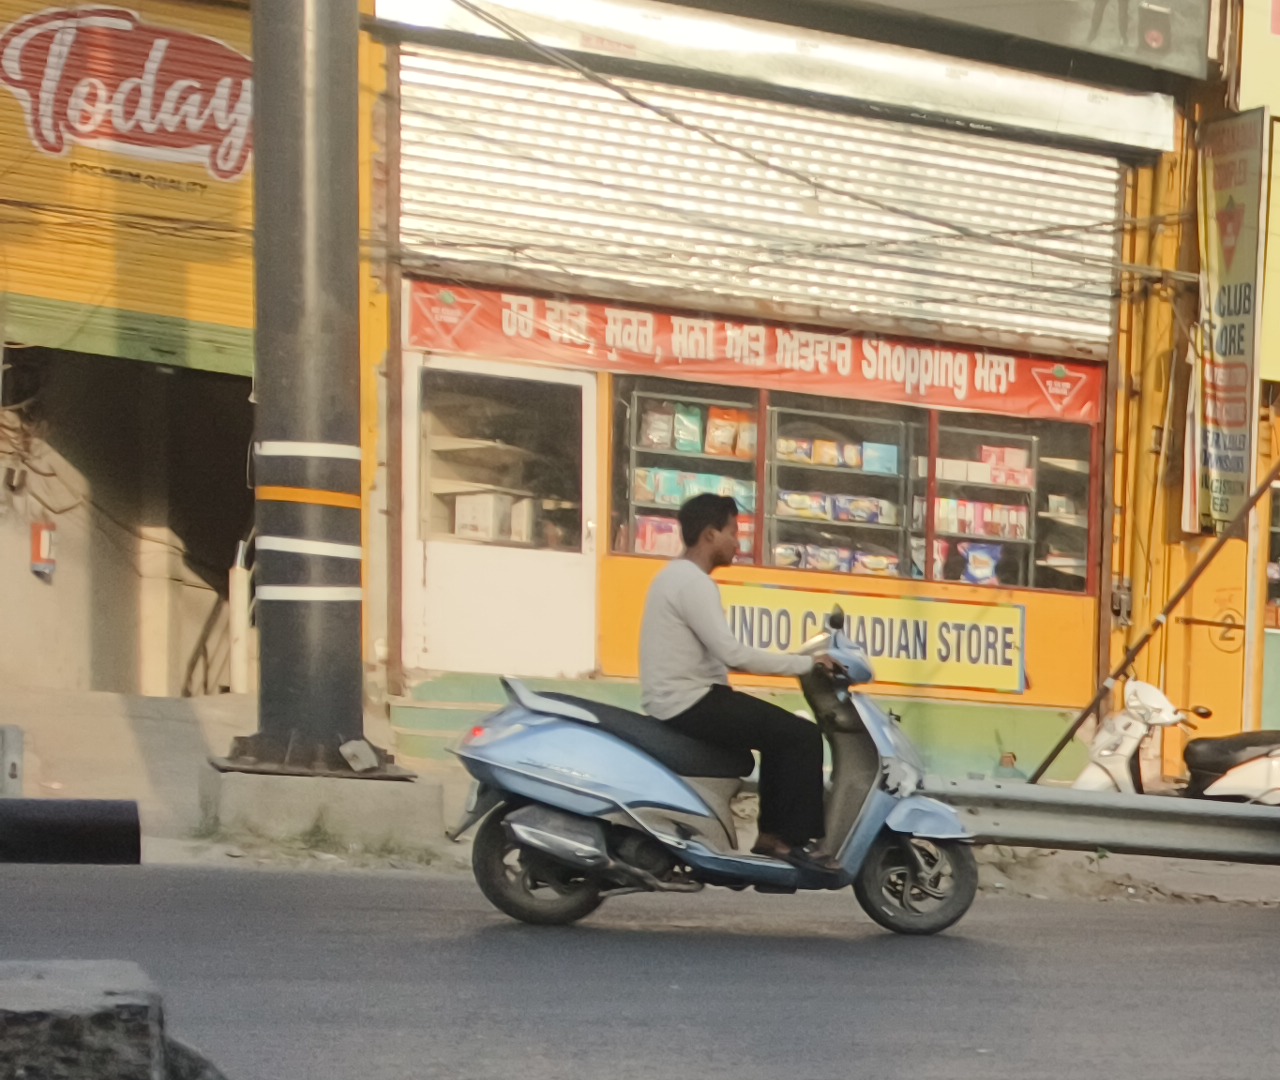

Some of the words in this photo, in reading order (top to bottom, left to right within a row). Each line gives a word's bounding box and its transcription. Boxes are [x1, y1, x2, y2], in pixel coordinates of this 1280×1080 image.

[1, 16, 252, 171] Today
[861, 329, 969, 400] Shopping
[729, 604, 791, 651] INDO
[937, 620, 1014, 667] STORE
[1219, 613, 1236, 641] 2
